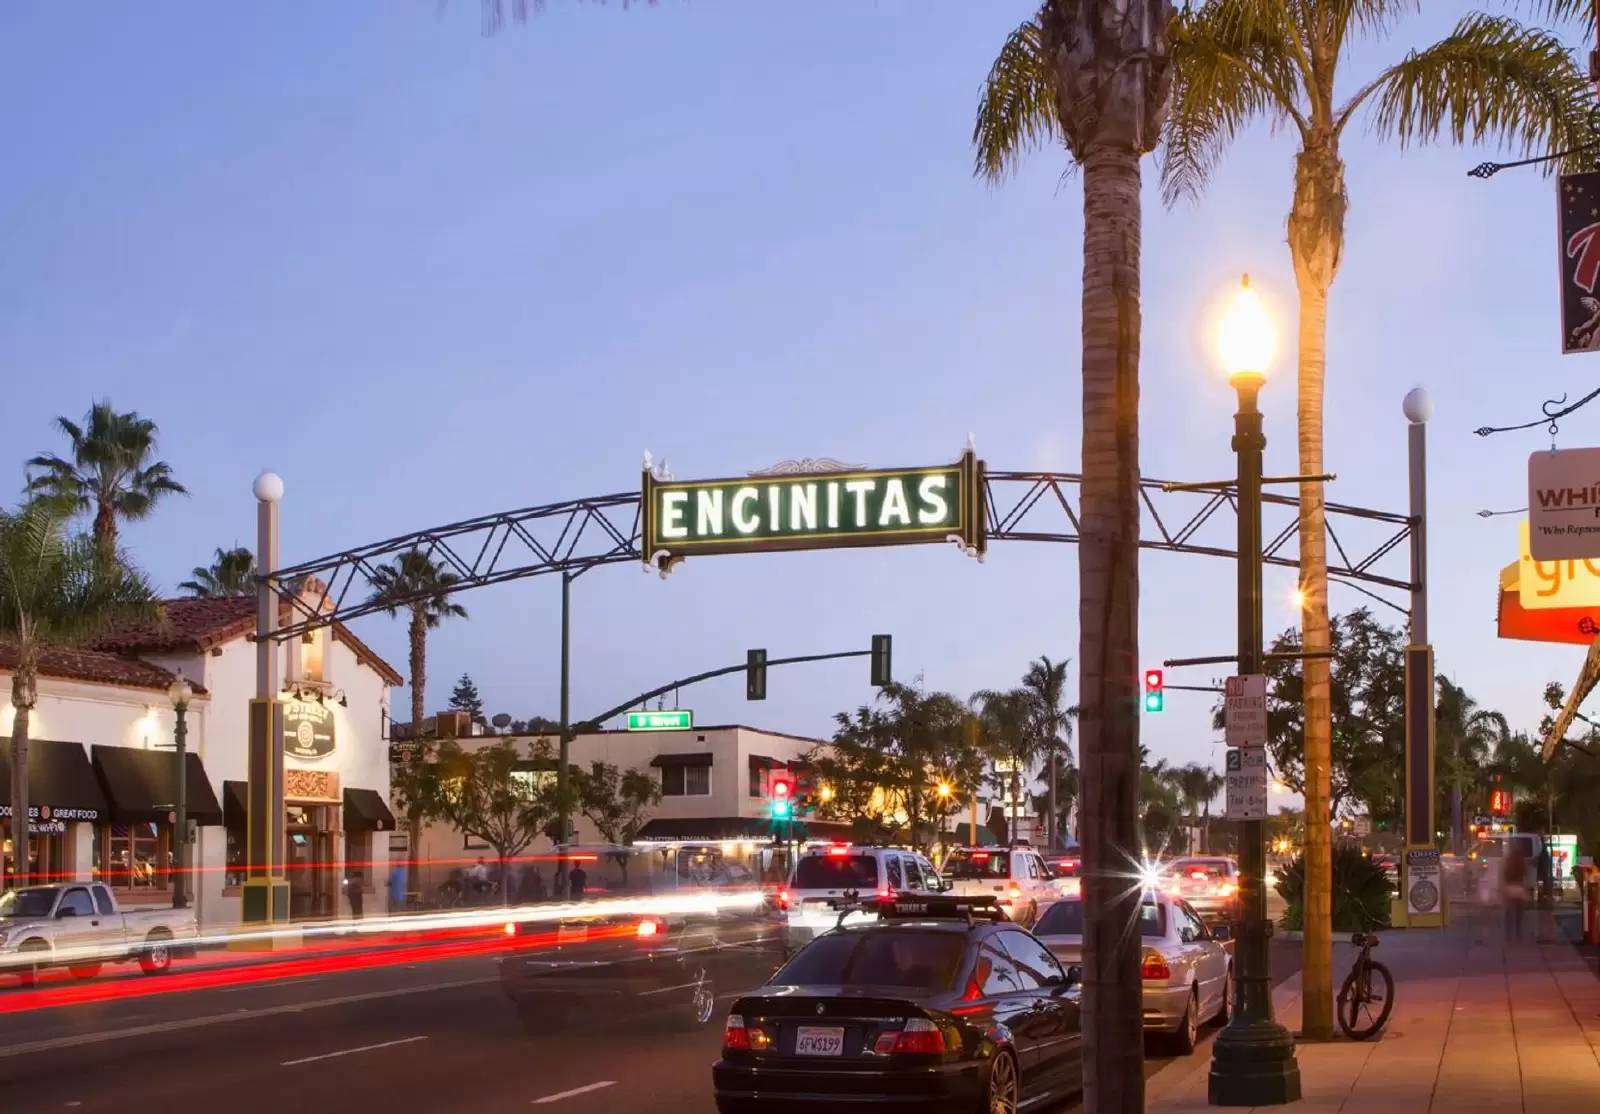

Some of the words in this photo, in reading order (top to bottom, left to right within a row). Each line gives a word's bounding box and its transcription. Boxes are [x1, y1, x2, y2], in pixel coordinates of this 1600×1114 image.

[1536, 487, 1600, 507] WHI
[661, 475, 949, 538] ENCINITAS
[1229, 752, 1240, 769] 2
[53, 808, 76, 818] GREAT
[77, 810, 98, 819] FOOD
